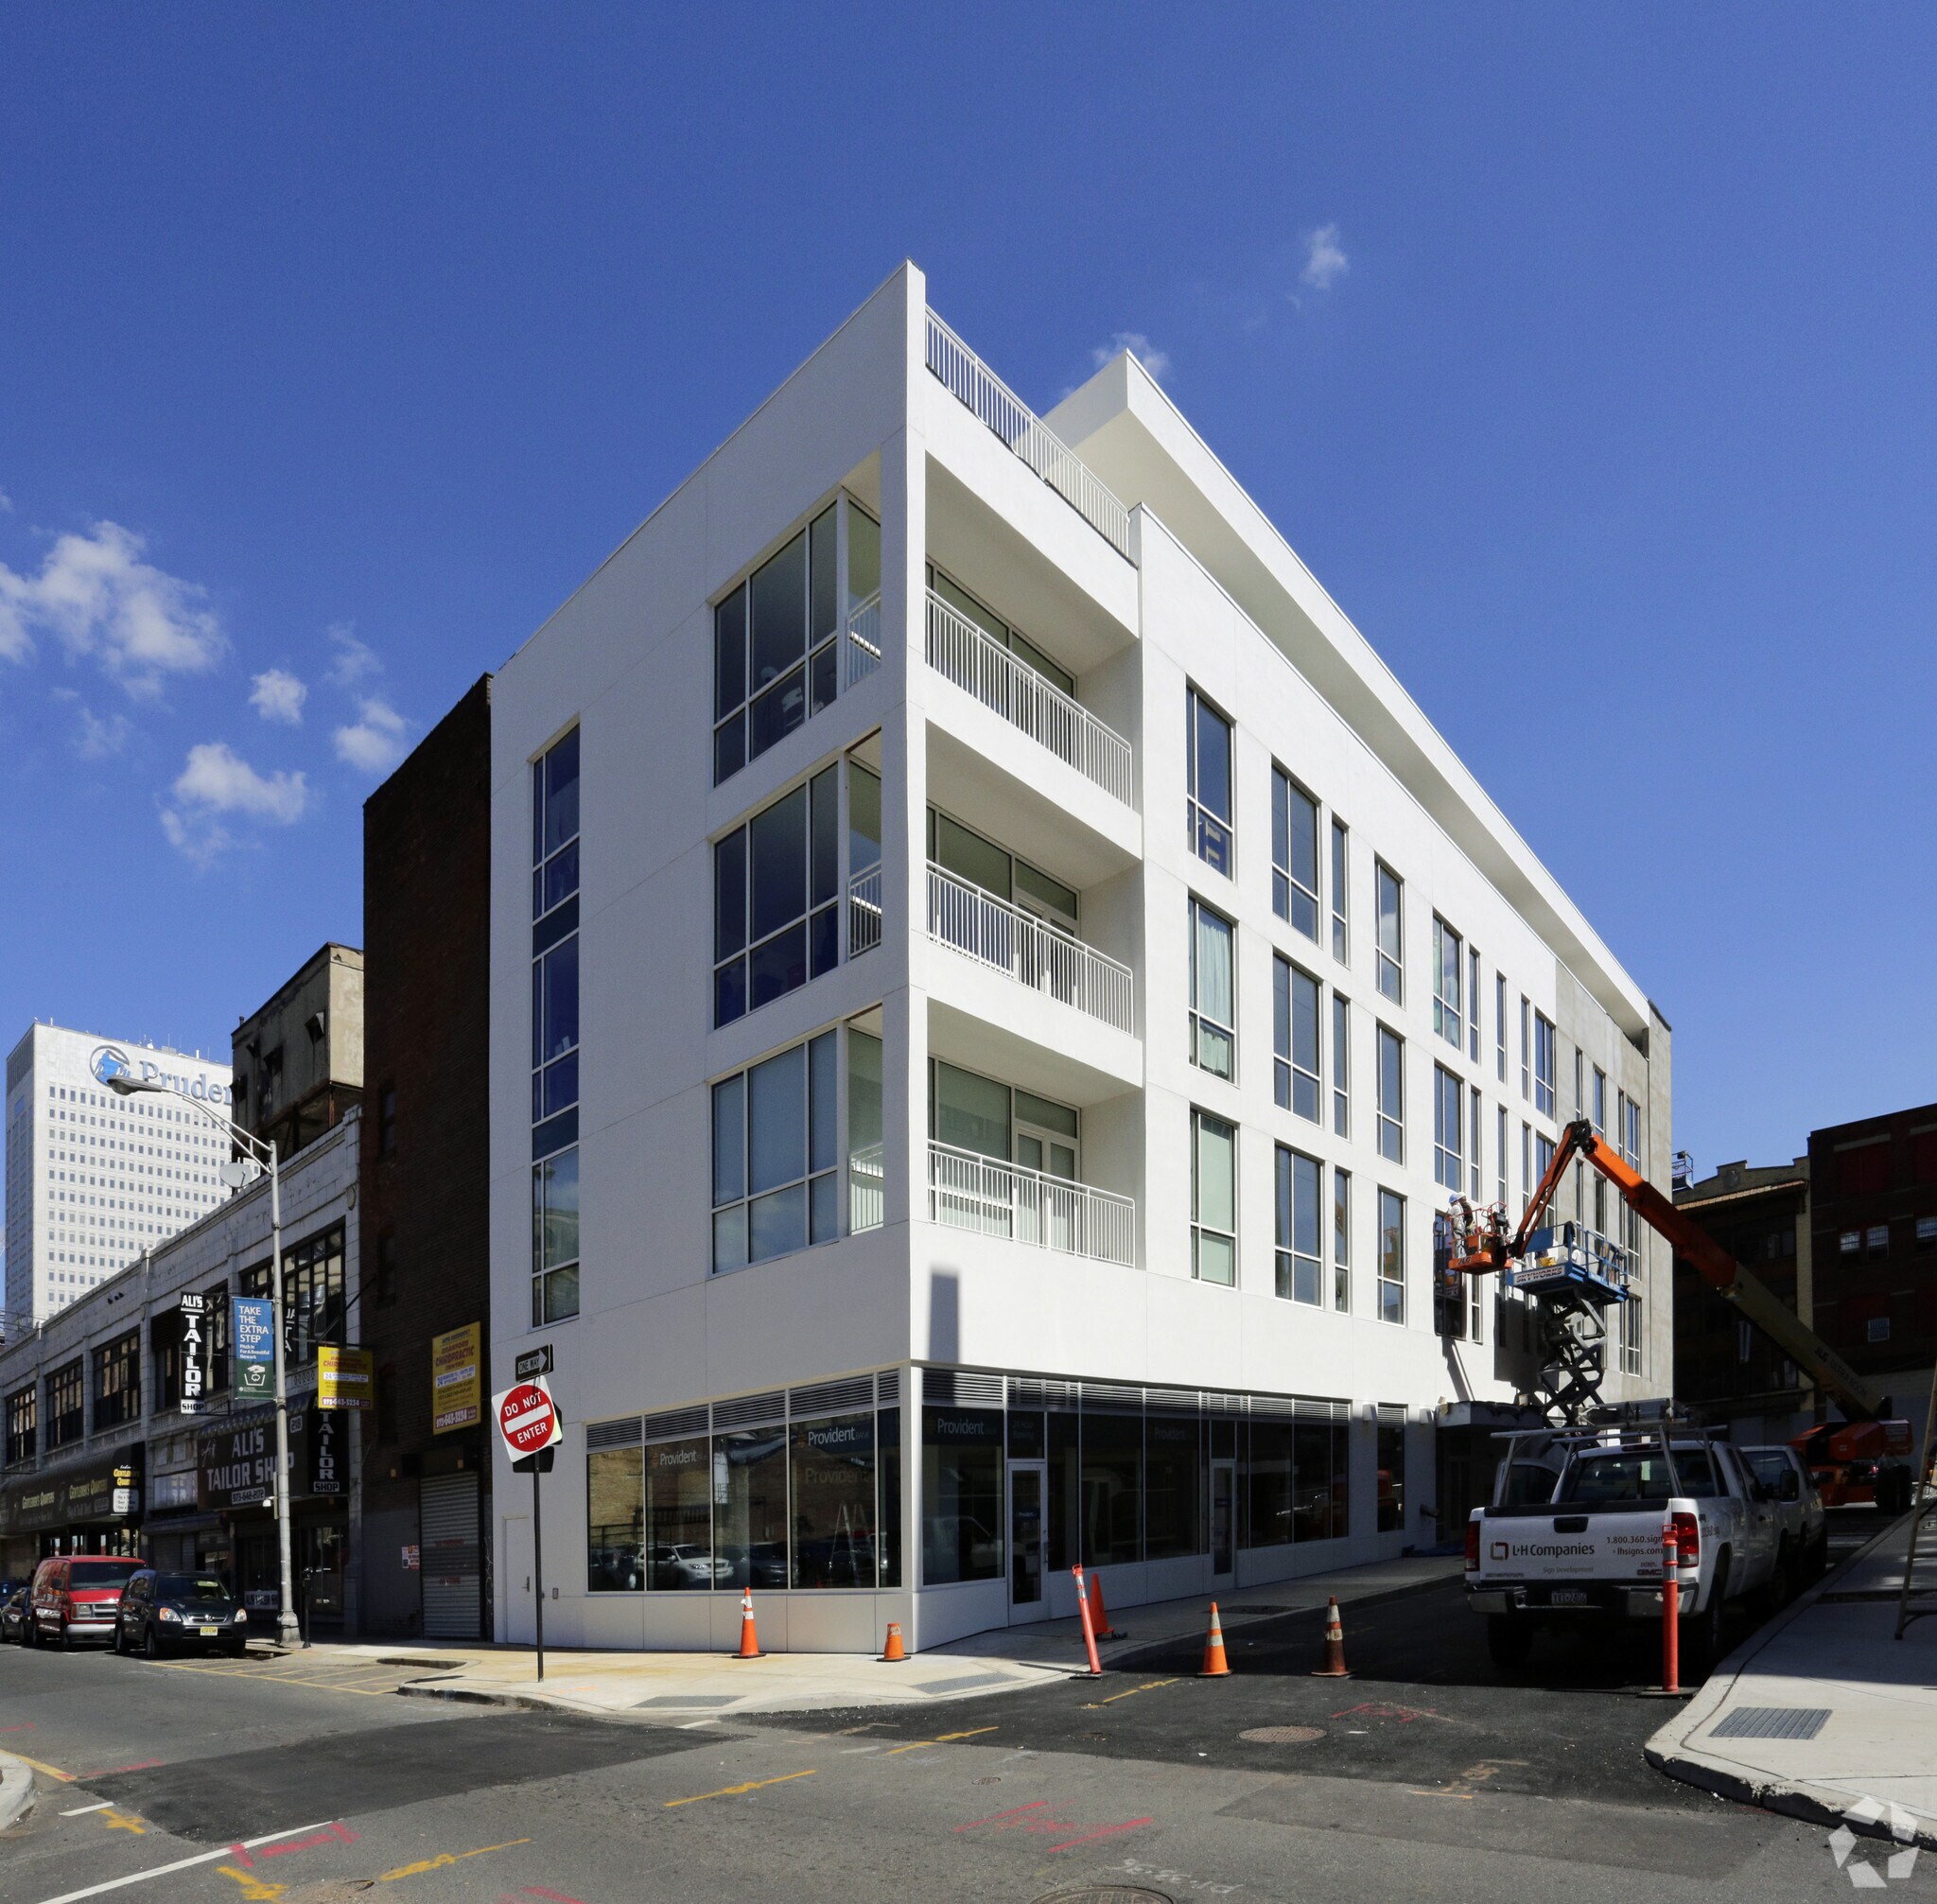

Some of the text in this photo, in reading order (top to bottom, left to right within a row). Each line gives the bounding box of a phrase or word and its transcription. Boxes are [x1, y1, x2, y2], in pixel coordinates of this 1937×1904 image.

[182, 1295, 203, 1308] ALI'S
[239, 1305, 261, 1316] TAKE
[239, 1315, 256, 1324] THE
[240, 1325, 269, 1335] EXTRA
[239, 1334, 261, 1343] STEP
[183, 1315, 201, 1397] TAILOR
[518, 1355, 540, 1373] ONE WAY
[182, 1403, 204, 1412] SHOP
[504, 1391, 542, 1417] DO NOT
[516, 1422, 548, 1444] ENTER
[937, 1418, 985, 1436] Provident
[1154, 1426, 1185, 1441] Provident
[232, 1427, 264, 1459] ALI'S
[808, 1426, 856, 1446] Provident
[318, 1411, 335, 1480] TAILOR
[660, 1450, 697, 1466] Provident
[207, 1452, 295, 1492] TAILOR SHP
[315, 1482, 339, 1492] SHOP
[1529, 1542, 1596, 1559] Companies
[1616, 1547, 1664, 1558] lhsigns.com
[1543, 1565, 1595, 1575] Sign Development
